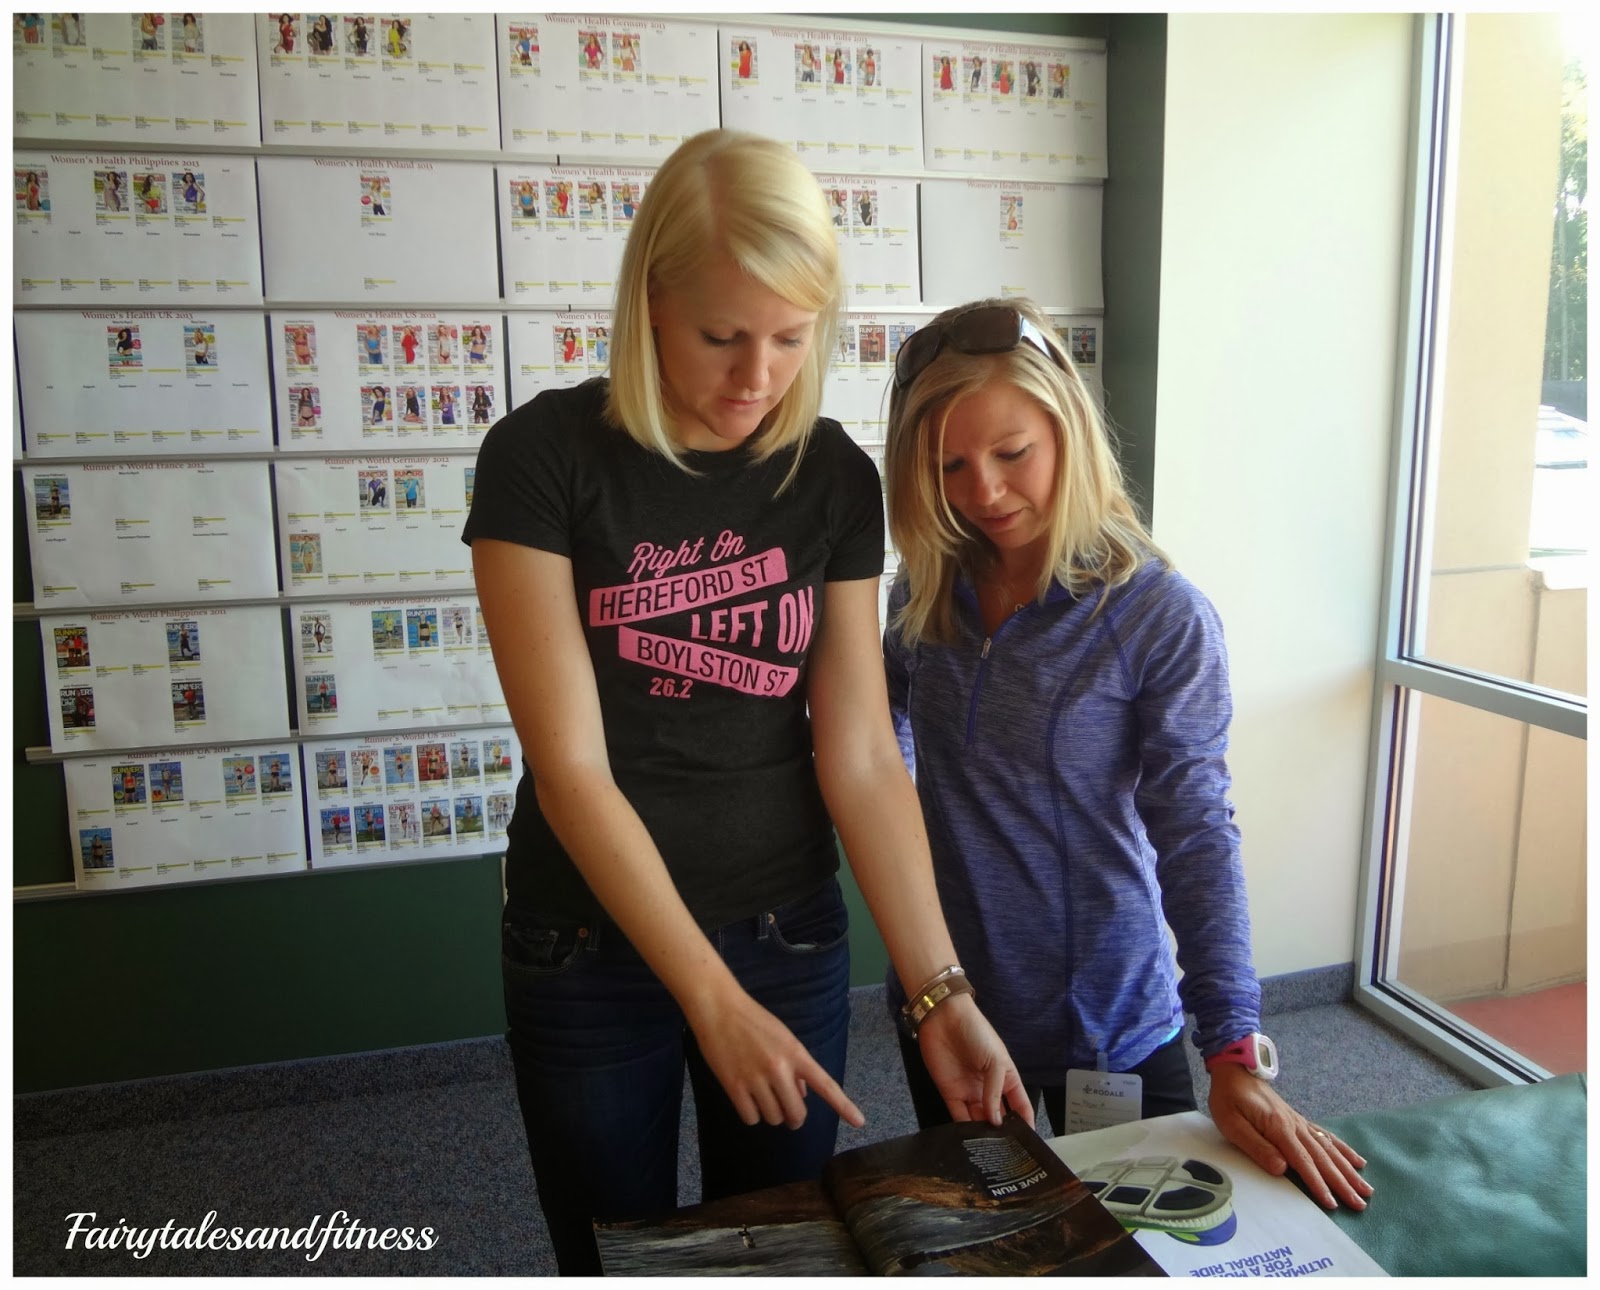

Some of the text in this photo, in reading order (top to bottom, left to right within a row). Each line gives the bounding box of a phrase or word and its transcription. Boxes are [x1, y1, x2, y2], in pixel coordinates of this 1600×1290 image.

[584, 16, 610, 26] Health
[612, 18, 647, 29] Germany
[807, 31, 831, 40] Health
[833, 32, 851, 41] India
[50, 155, 94, 165] Women's
[96, 156, 126, 165] Health
[129, 157, 179, 168] Philippines
[182, 160, 200, 168] 2013
[314, 158, 354, 167] Women's
[356, 159, 384, 168] Health
[386, 160, 414, 169] Poland
[550, 167, 587, 176] Women's
[588, 168, 615, 176] Health
[617, 168, 642, 177] Russia
[839, 176, 860, 184] Africa
[81, 311, 122, 320] Women's
[126, 311, 156, 319] Health
[158, 311, 173, 319] UK
[334, 311, 372, 319] Women's
[375, 311, 403, 319] Health
[555, 312, 592, 320] Women's
[325, 457, 362, 465] Runner's
[366, 456, 391, 464] World
[392, 456, 430, 465] Germany
[83, 463, 124, 471] Runner's
[127, 462, 154, 470] World
[626, 529, 746, 582] Right On
[600, 556, 768, 621] HEREFORD ST
[90, 612, 130, 620] Runner's
[132, 610, 158, 618] World
[161, 609, 208, 619] Philippines
[691, 585, 814, 654] LEFT ON
[637, 635, 789, 693] BOYLSTON ST
[650, 677, 694, 698] 26.2
[364, 736, 400, 744] Runner's
[402, 732, 425, 741] World
[1093, 1088, 1125, 1097] RODALE
[991, 1170, 1048, 1197] RAVE RUN
[1189, 1246, 1293, 1277] NATURAL RIDE
[1263, 1257, 1293, 1273] FOR
[1250, 1266, 1261, 1277] A
